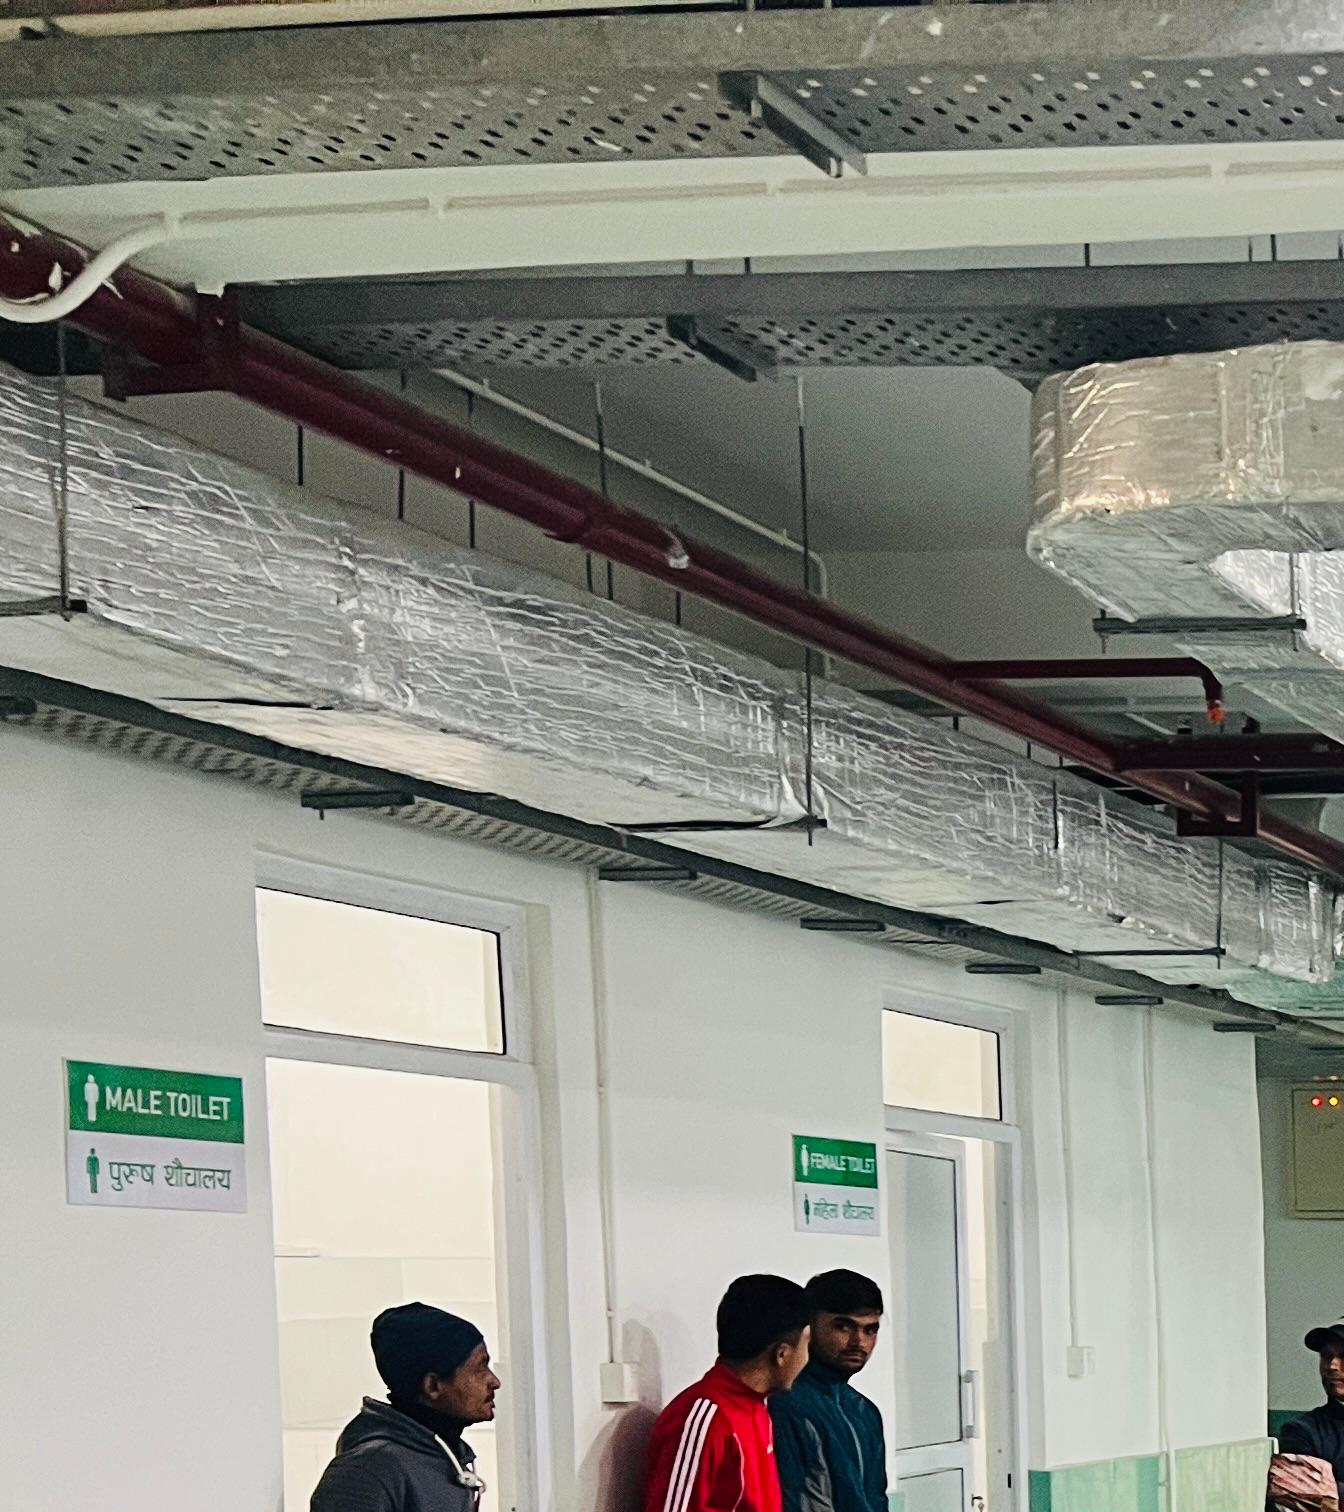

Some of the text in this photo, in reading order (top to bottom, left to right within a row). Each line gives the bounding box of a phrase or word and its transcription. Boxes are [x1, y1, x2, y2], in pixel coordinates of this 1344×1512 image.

[105, 1086, 231, 1121] MALE TOILET
[164, 1157, 231, 1190] शौचालय
